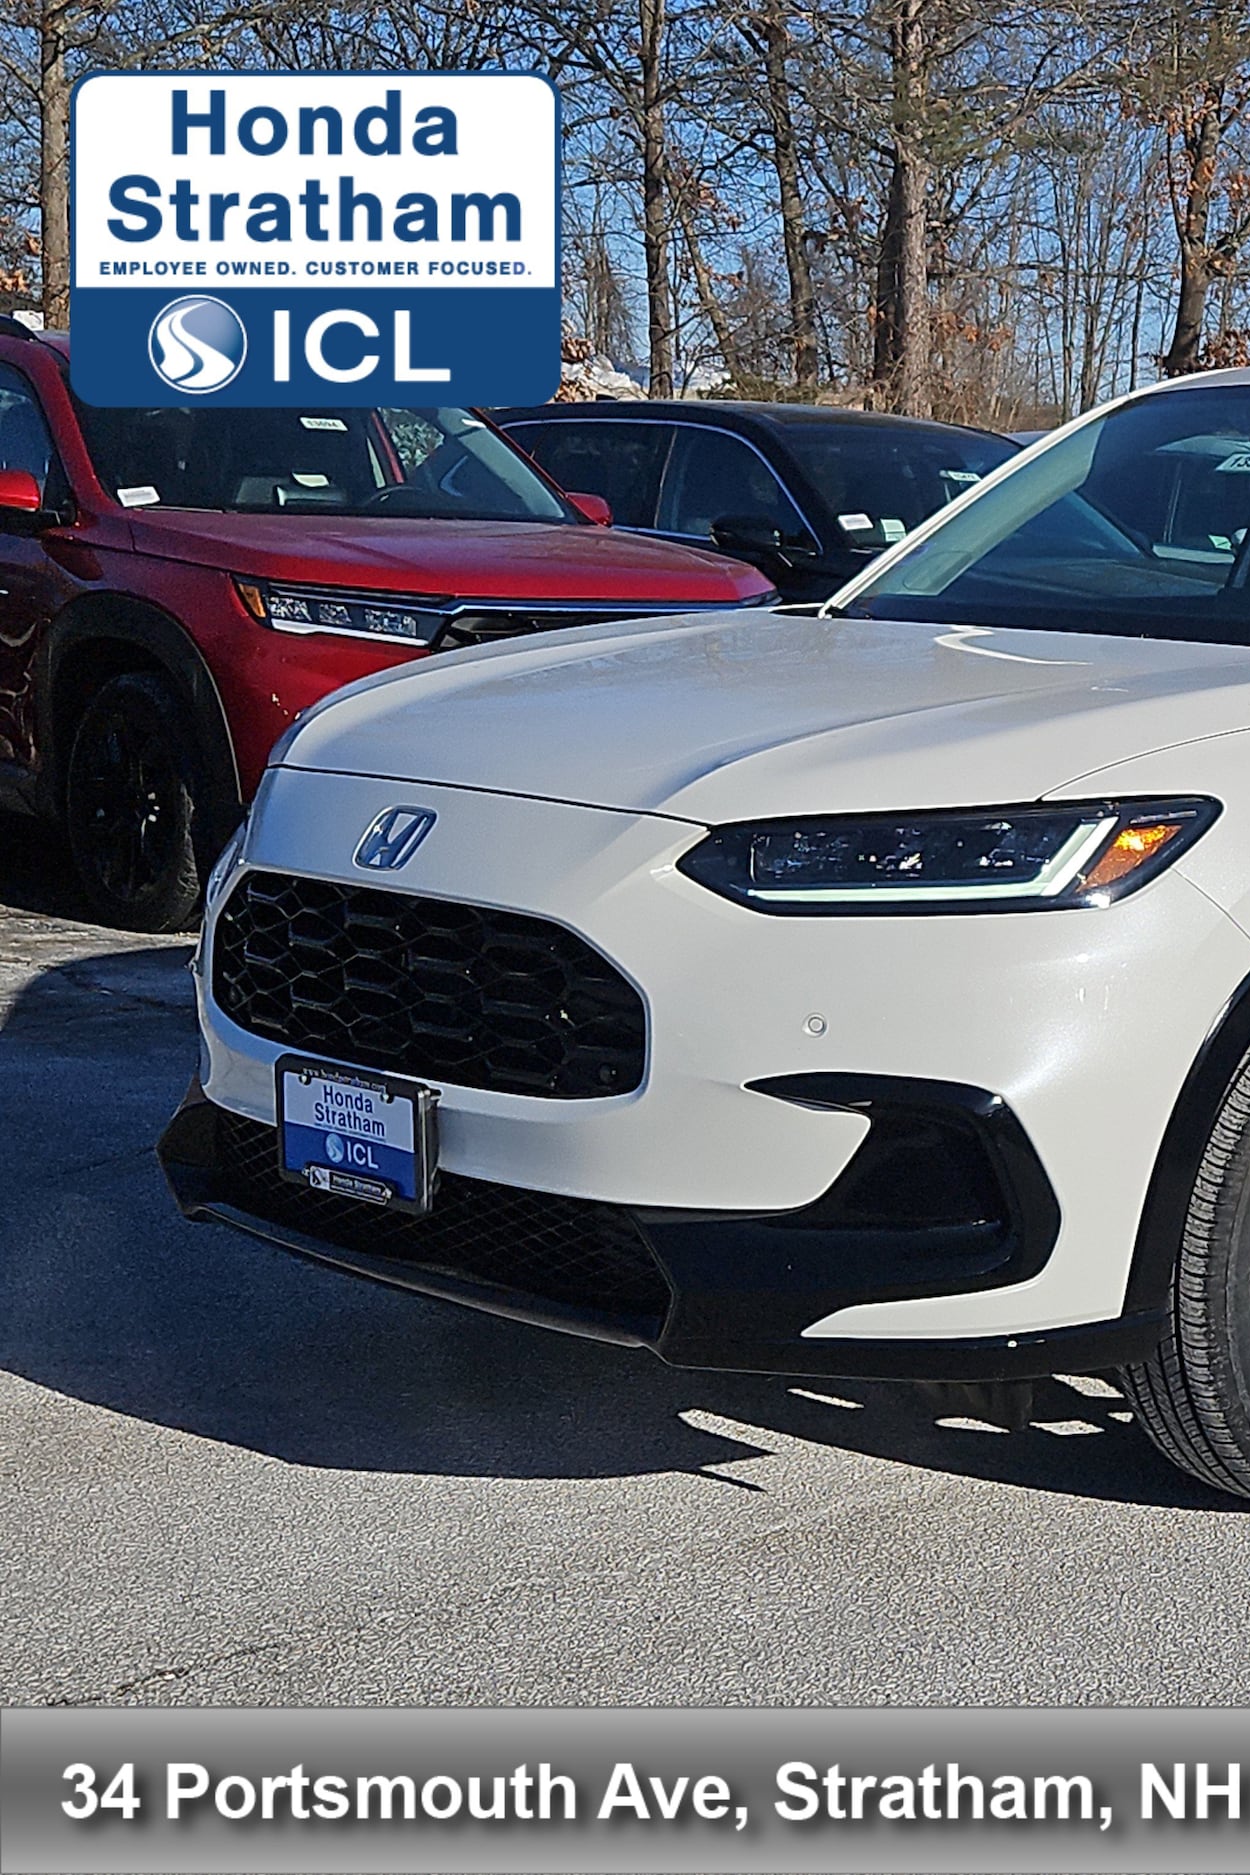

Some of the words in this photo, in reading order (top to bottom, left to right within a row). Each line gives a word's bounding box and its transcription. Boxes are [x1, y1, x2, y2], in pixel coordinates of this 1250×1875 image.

[323, 1084, 374, 1114] Honda
[314, 1102, 386, 1138] Stratham
[346, 1140, 380, 1170] ICL
